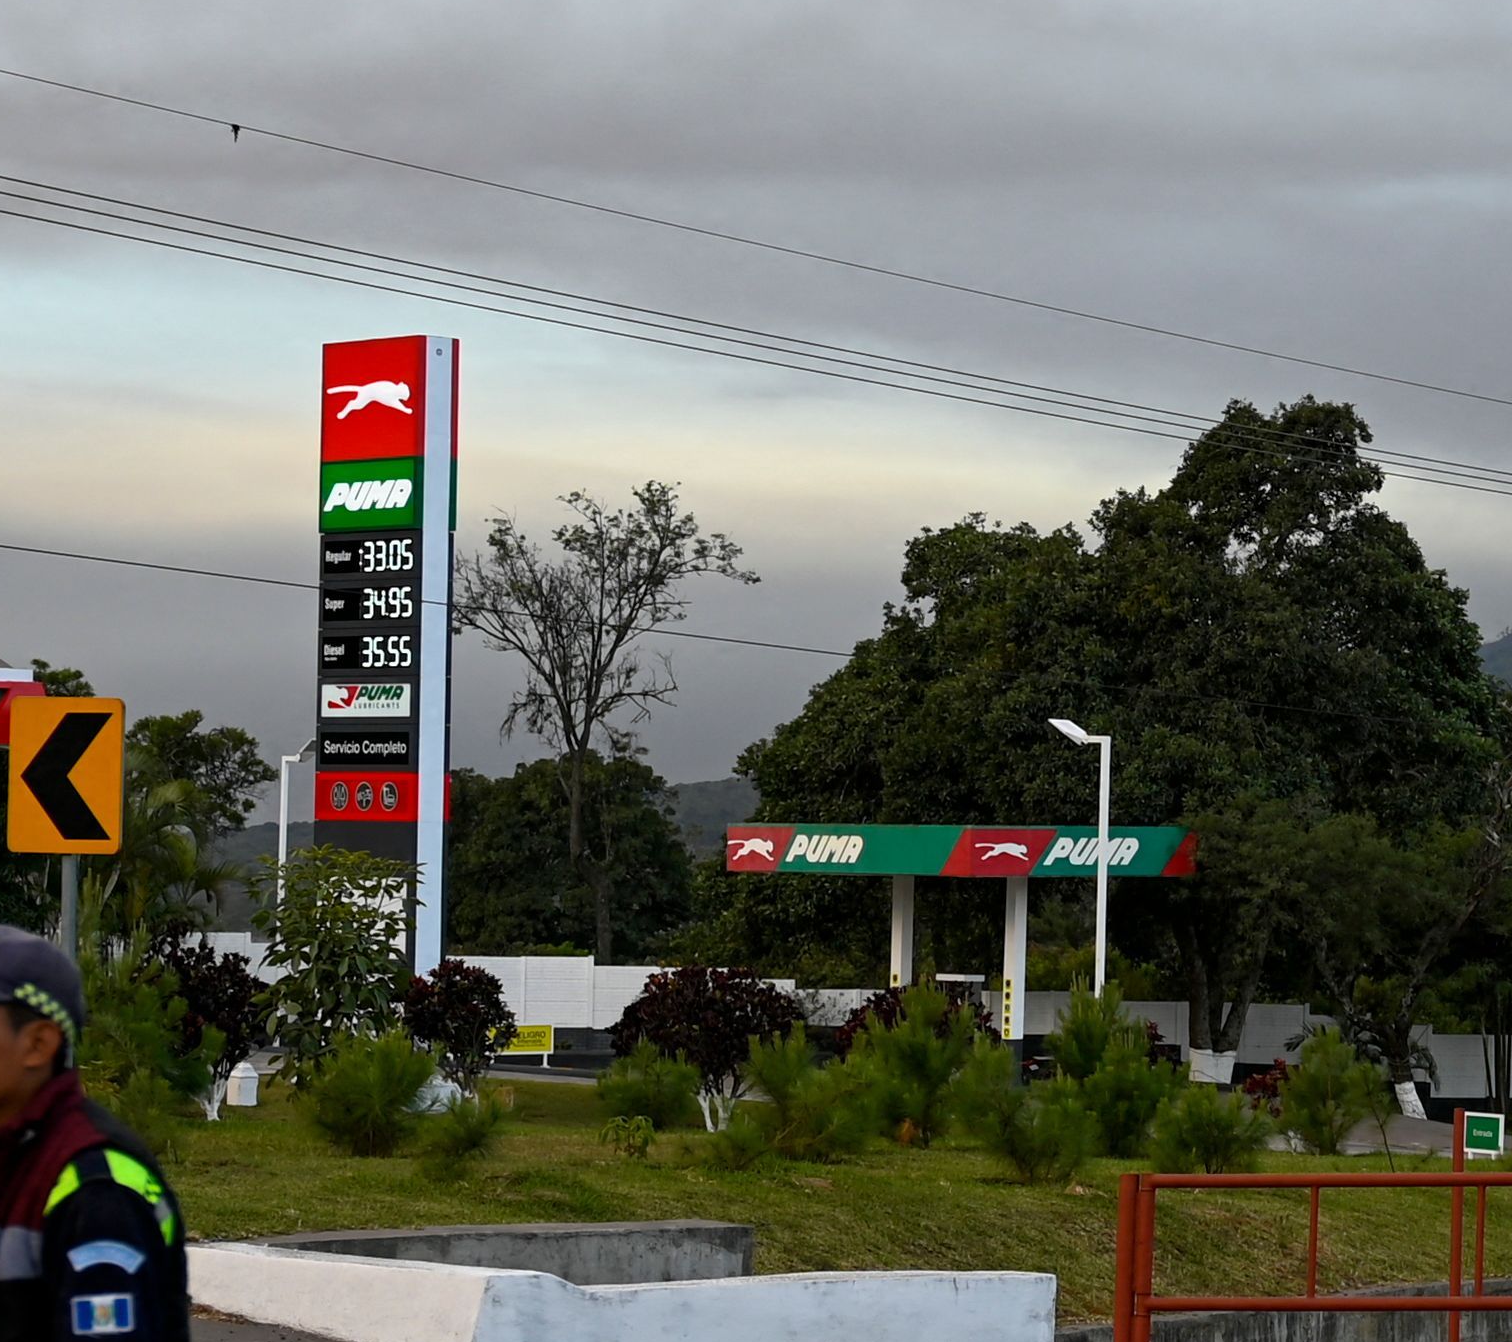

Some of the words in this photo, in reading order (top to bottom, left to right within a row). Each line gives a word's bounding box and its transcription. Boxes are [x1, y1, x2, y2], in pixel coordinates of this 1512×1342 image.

[324, 477, 412, 512] PUMA
[325, 550, 352, 564] Regular
[363, 539, 413, 572] 33.05
[324, 597, 345, 612] Super
[362, 586, 413, 619] 34.95
[323, 643, 345, 656] Diesel
[361, 635, 412, 667] 35.55
[355, 685, 404, 701] PUMA
[324, 739, 361, 754] Servicio
[362, 740, 407, 757] Completo
[785, 834, 864, 864] PUMA
[1043, 837, 1140, 866] PUMA
